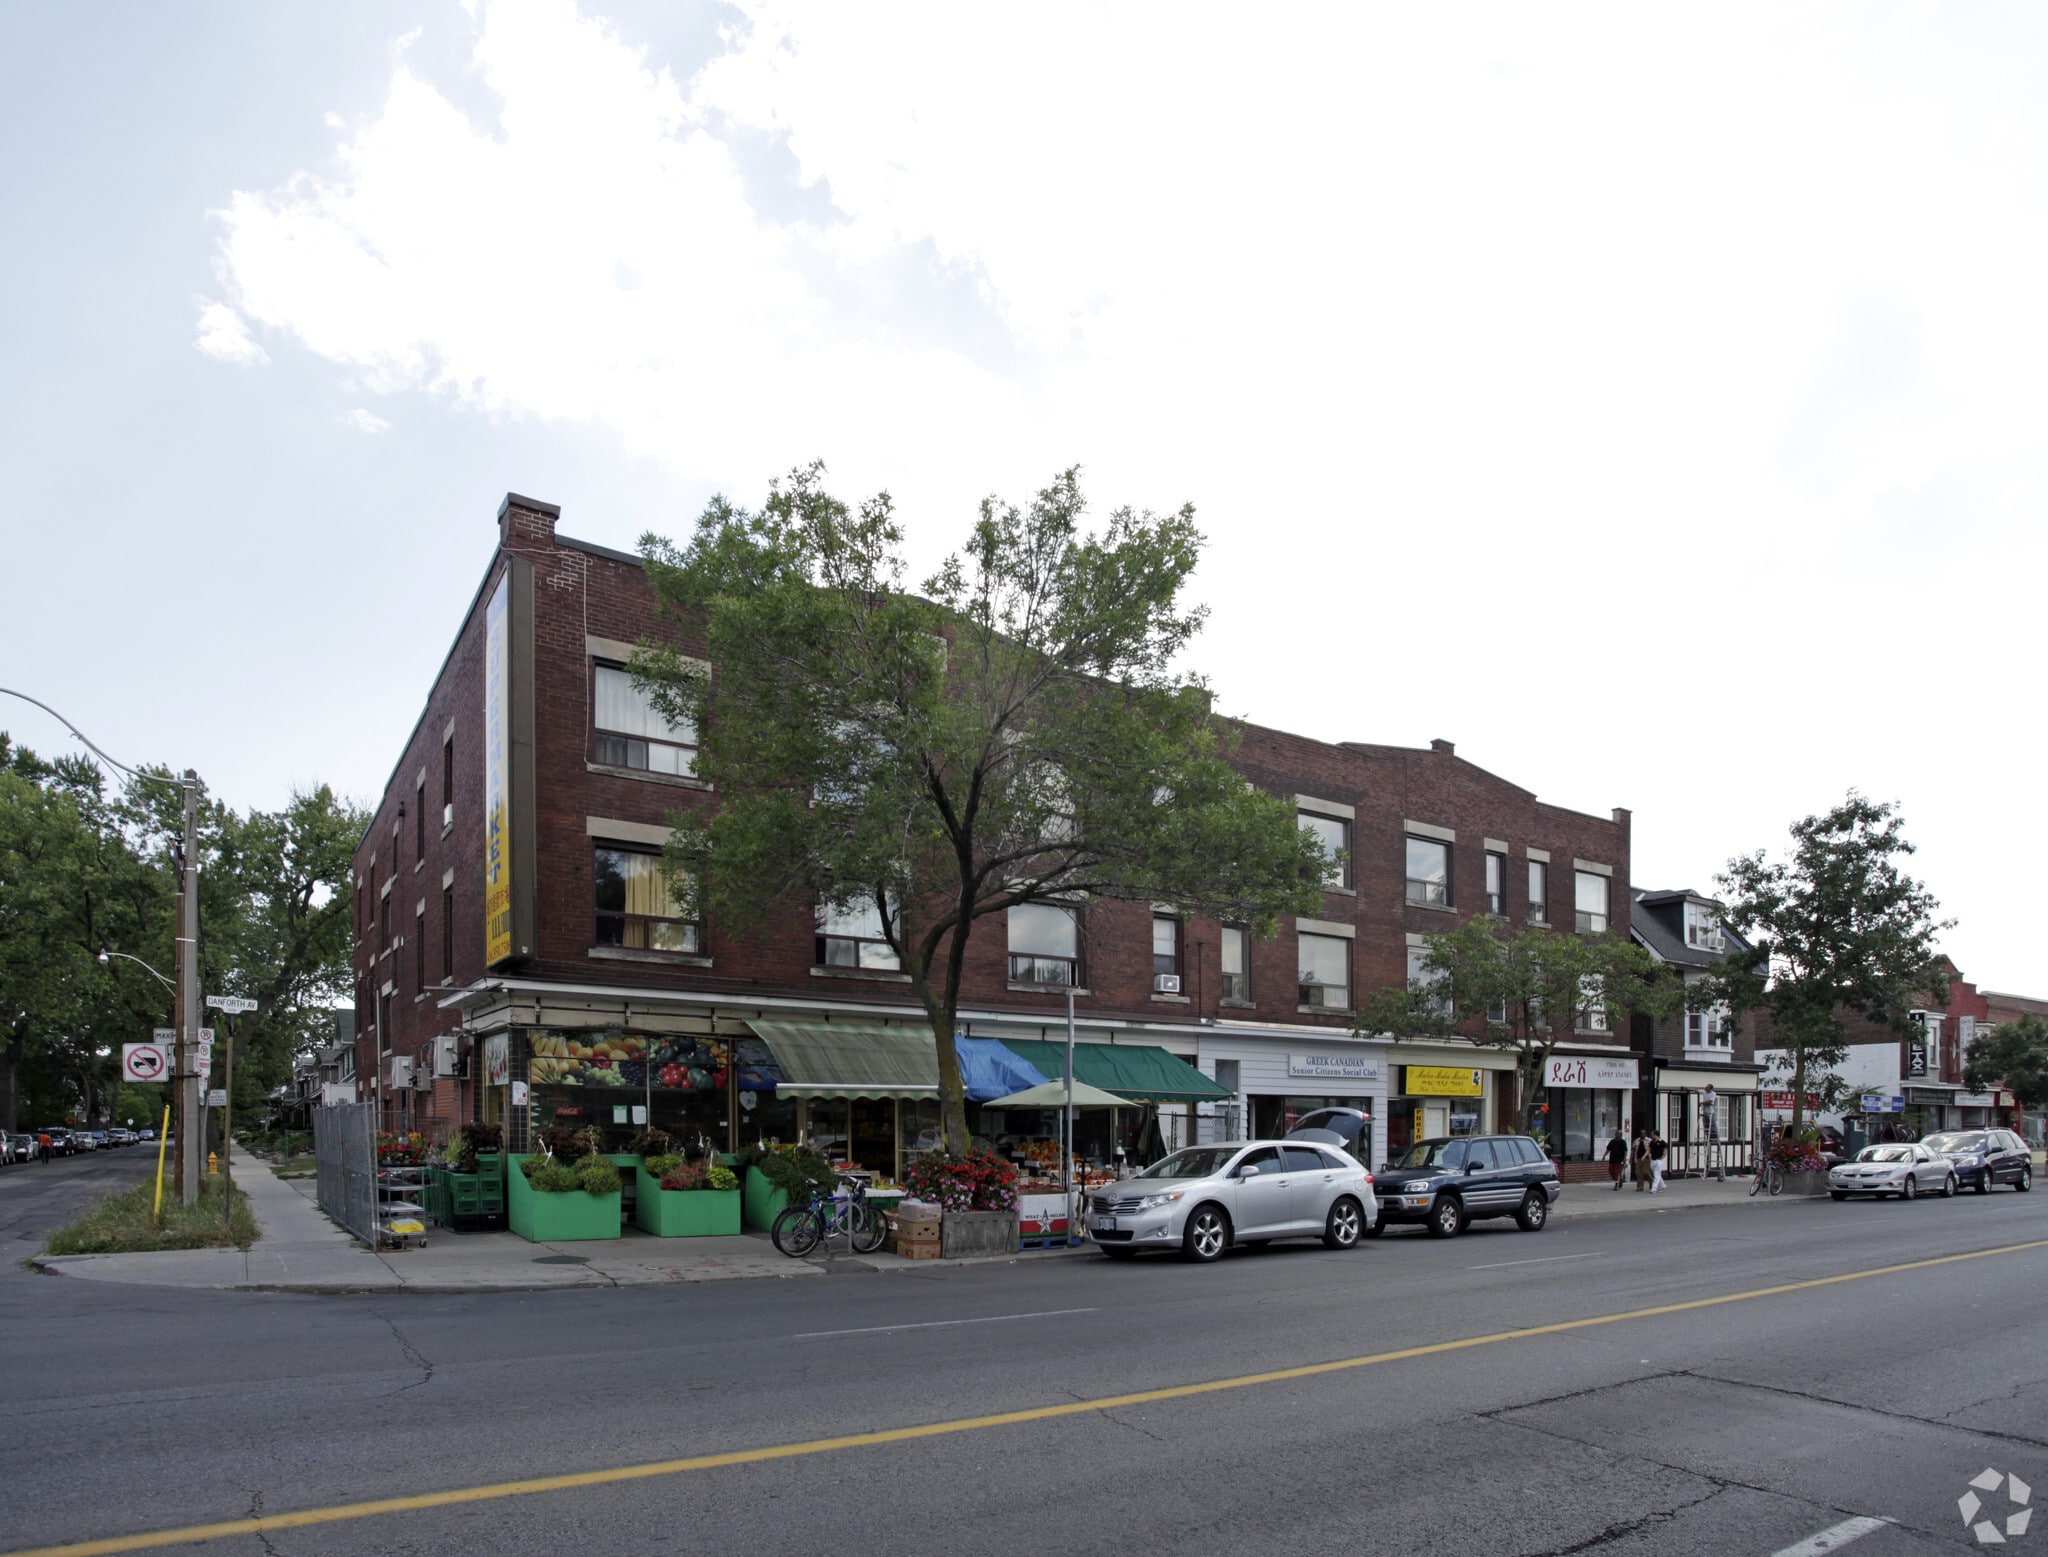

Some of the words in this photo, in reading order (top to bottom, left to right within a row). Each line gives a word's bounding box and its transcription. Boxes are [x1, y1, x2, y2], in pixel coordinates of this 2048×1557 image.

[208, 997, 246, 1008] DANFORTH
[247, 1001, 256, 1009] AV
[1306, 1056, 1329, 1066] GREEK
[1330, 1057, 1365, 1067] CANADIAN
[1911, 1052, 1924, 1070] TAX
[1292, 1066, 1313, 1075] Senior
[1315, 1067, 1341, 1076] Citizens
[1342, 1068, 1361, 1076] Social
[1362, 1068, 1377, 1077] Club
